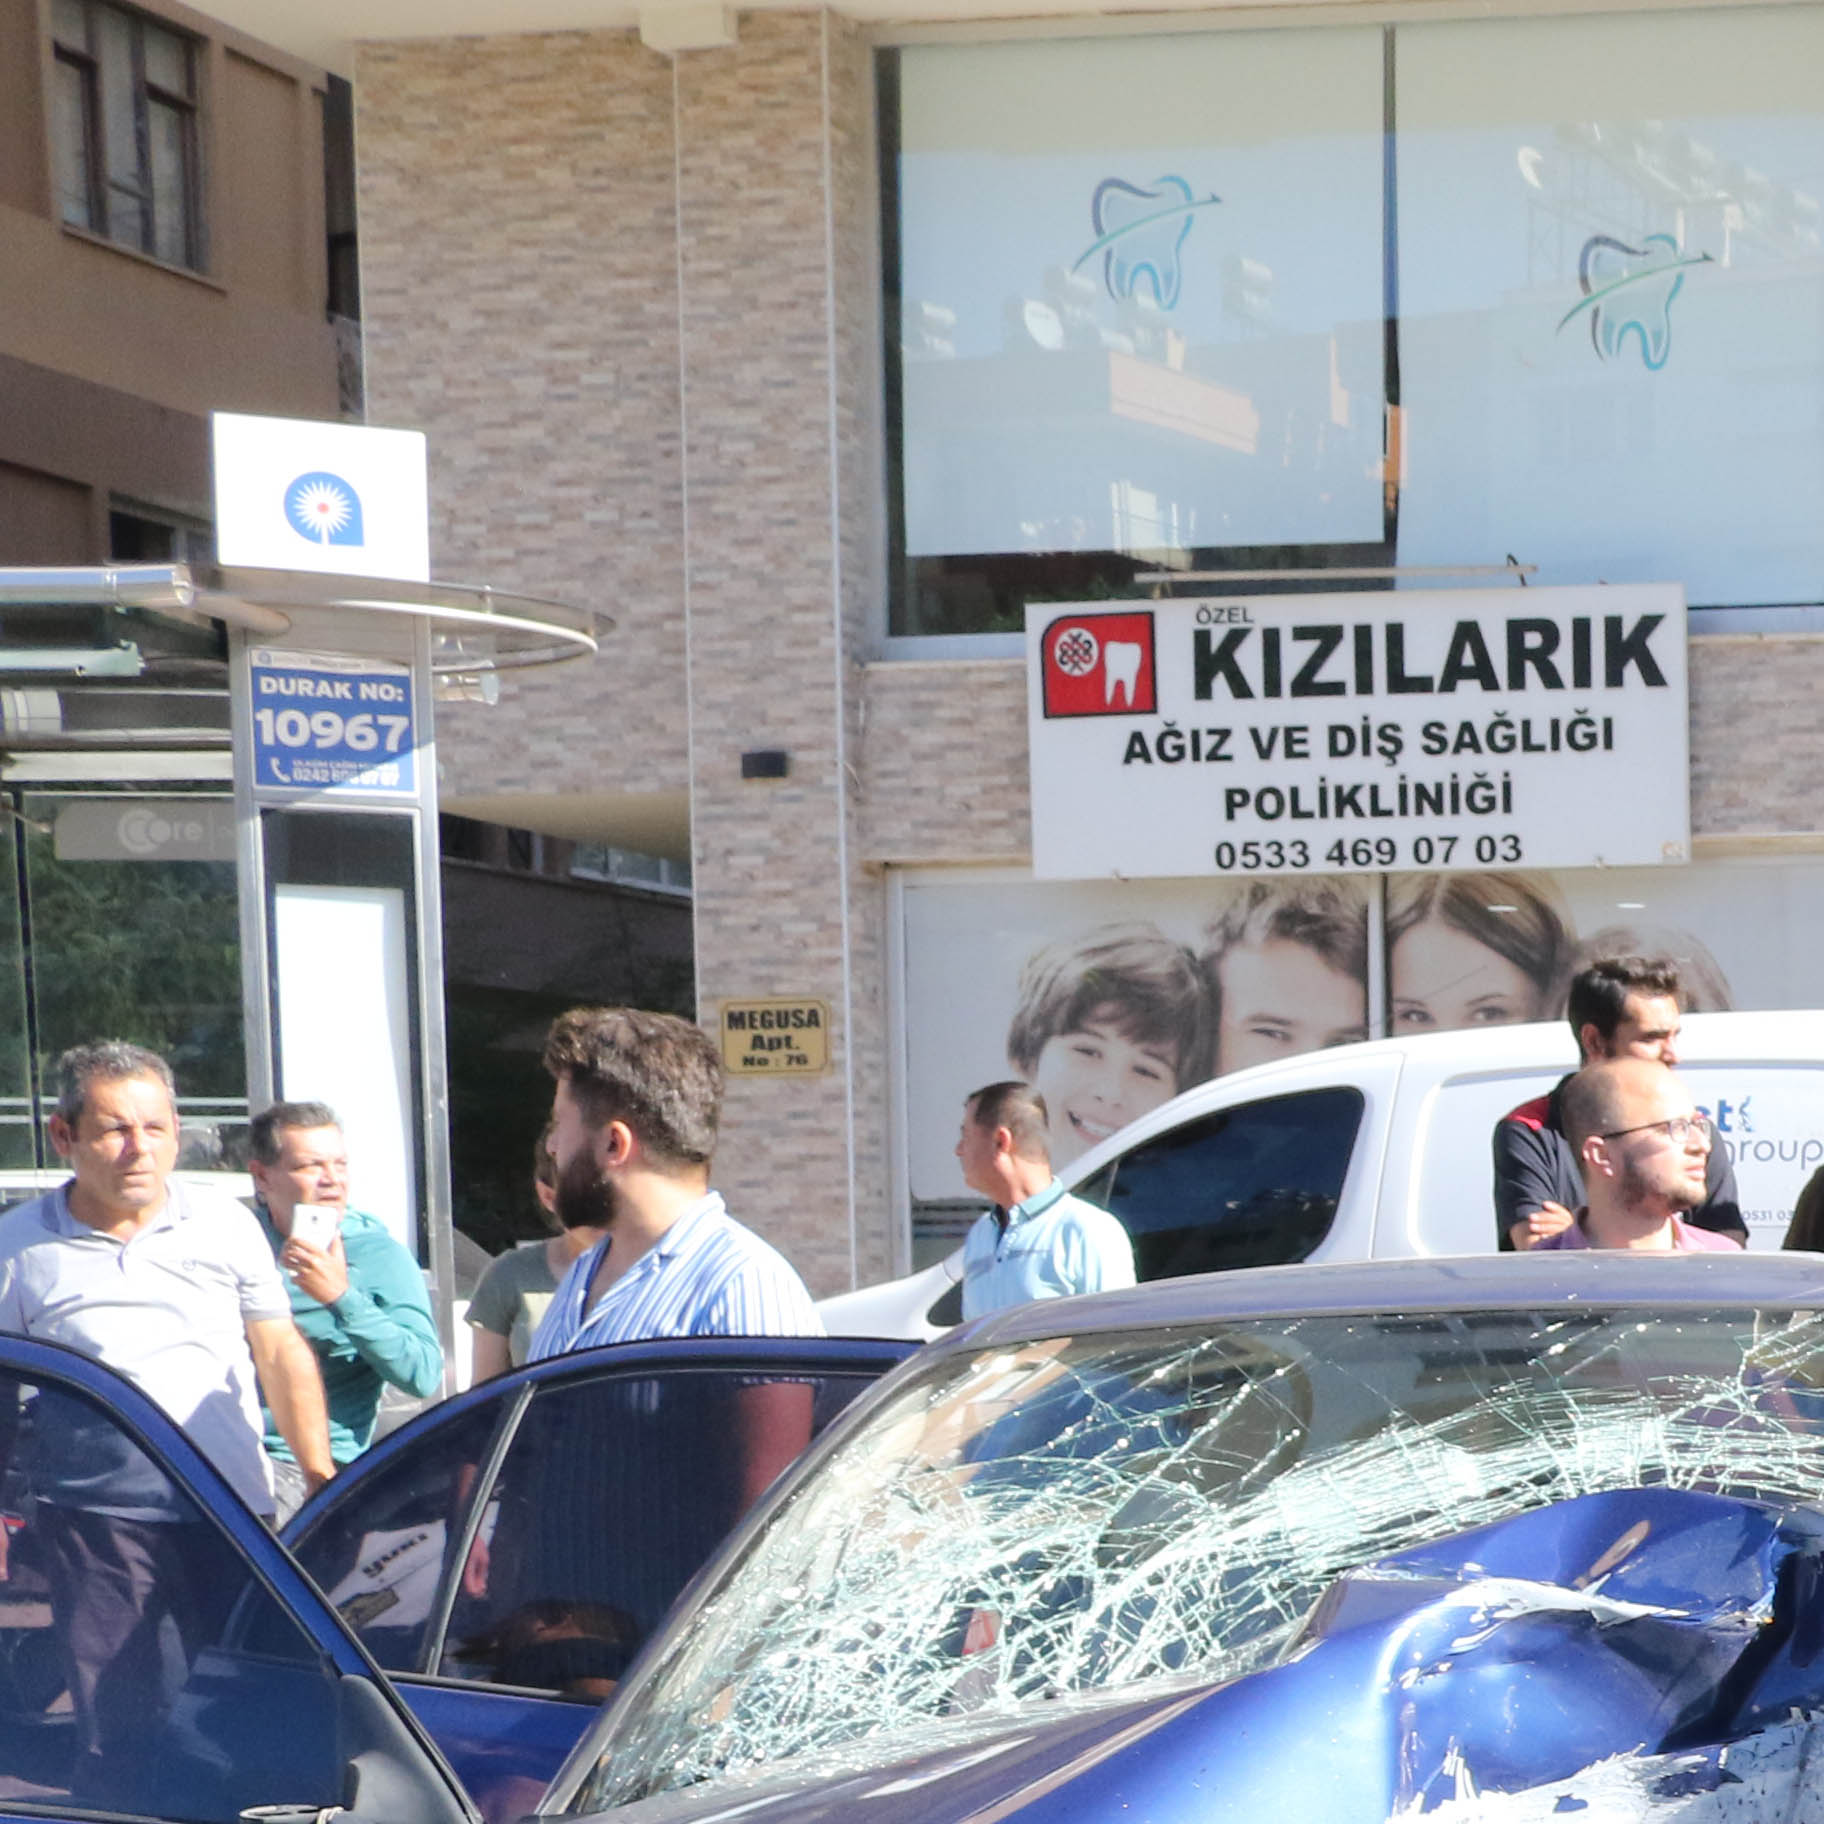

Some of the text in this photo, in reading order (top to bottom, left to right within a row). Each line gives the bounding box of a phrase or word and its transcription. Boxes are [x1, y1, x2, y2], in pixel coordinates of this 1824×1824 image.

[1195, 605, 1254, 625] ÖZEL
[1193, 614, 1668, 700] KIZILARIK
[259, 675, 404, 702] DURAK NO:
[255, 707, 409, 752] 10967
[1122, 709, 1614, 766] AĞIZ VE DİŞ SAĞLIĞI
[1224, 771, 1514, 822] POLİKLİNİĞİ
[1214, 833, 1523, 870] 0533 469 07 03
[726, 1008, 820, 1030] MEGUSA
[751, 1034, 801, 1052] Apt.
